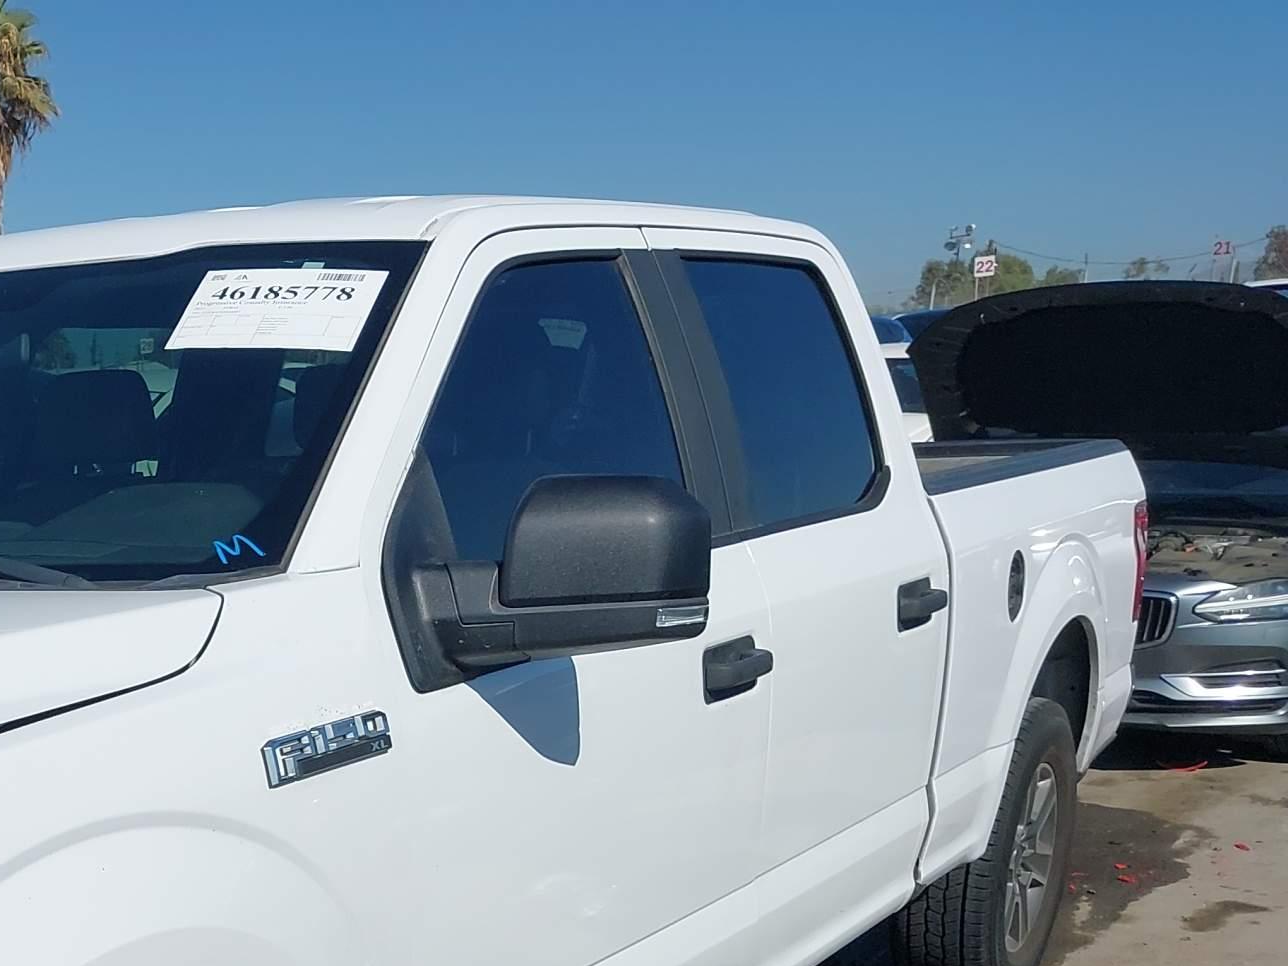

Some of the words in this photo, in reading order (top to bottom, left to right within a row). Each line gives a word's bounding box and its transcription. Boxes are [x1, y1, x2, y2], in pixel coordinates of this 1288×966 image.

[1213, 240, 1232, 256] 21
[976, 260, 994, 273] 22
[211, 285, 357, 302] 46185778
[213, 534, 267, 565] M
[370, 739, 389, 752] XL
